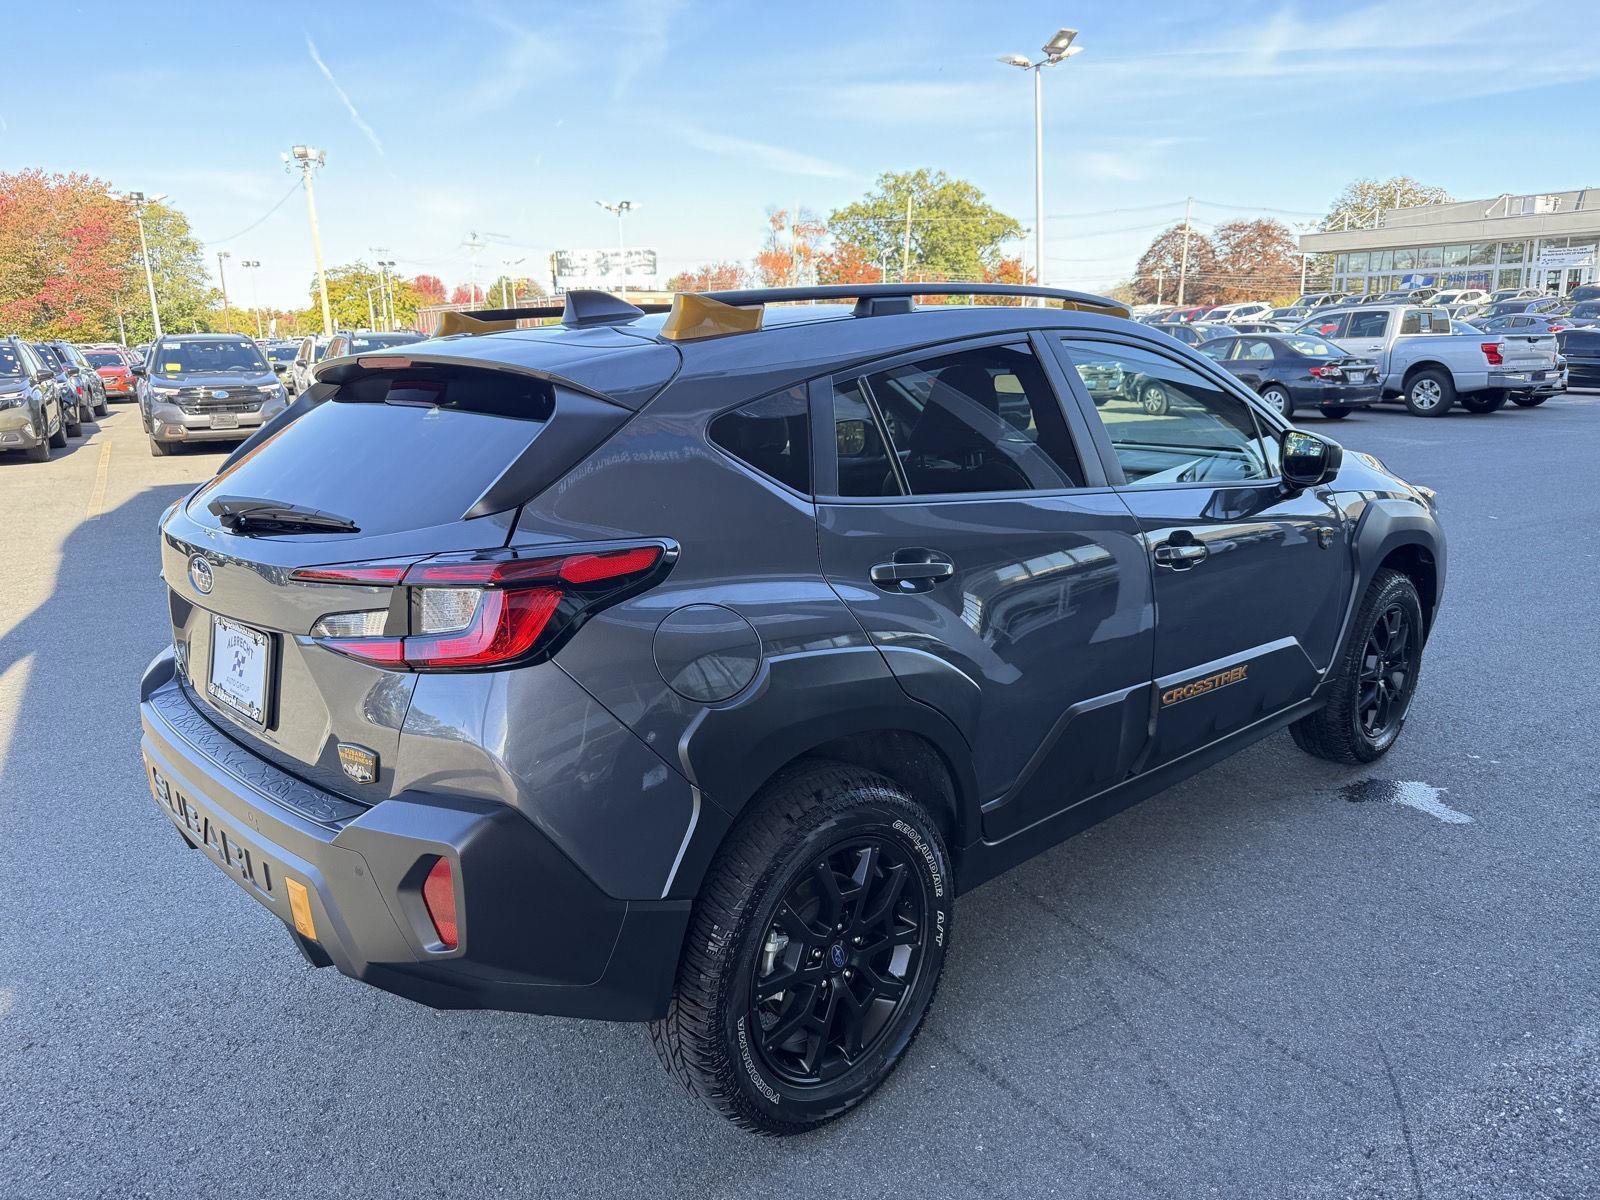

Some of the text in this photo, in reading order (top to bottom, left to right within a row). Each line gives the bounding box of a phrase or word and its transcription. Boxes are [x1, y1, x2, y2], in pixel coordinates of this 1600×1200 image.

[227, 635, 254, 660] ALBRECHT
[1162, 664, 1248, 705] CROSSTREK
[152, 766, 274, 901] SUBARU
[892, 820, 944, 898] GEOLANDAR
[737, 1015, 780, 1105] YOKOHAMA
